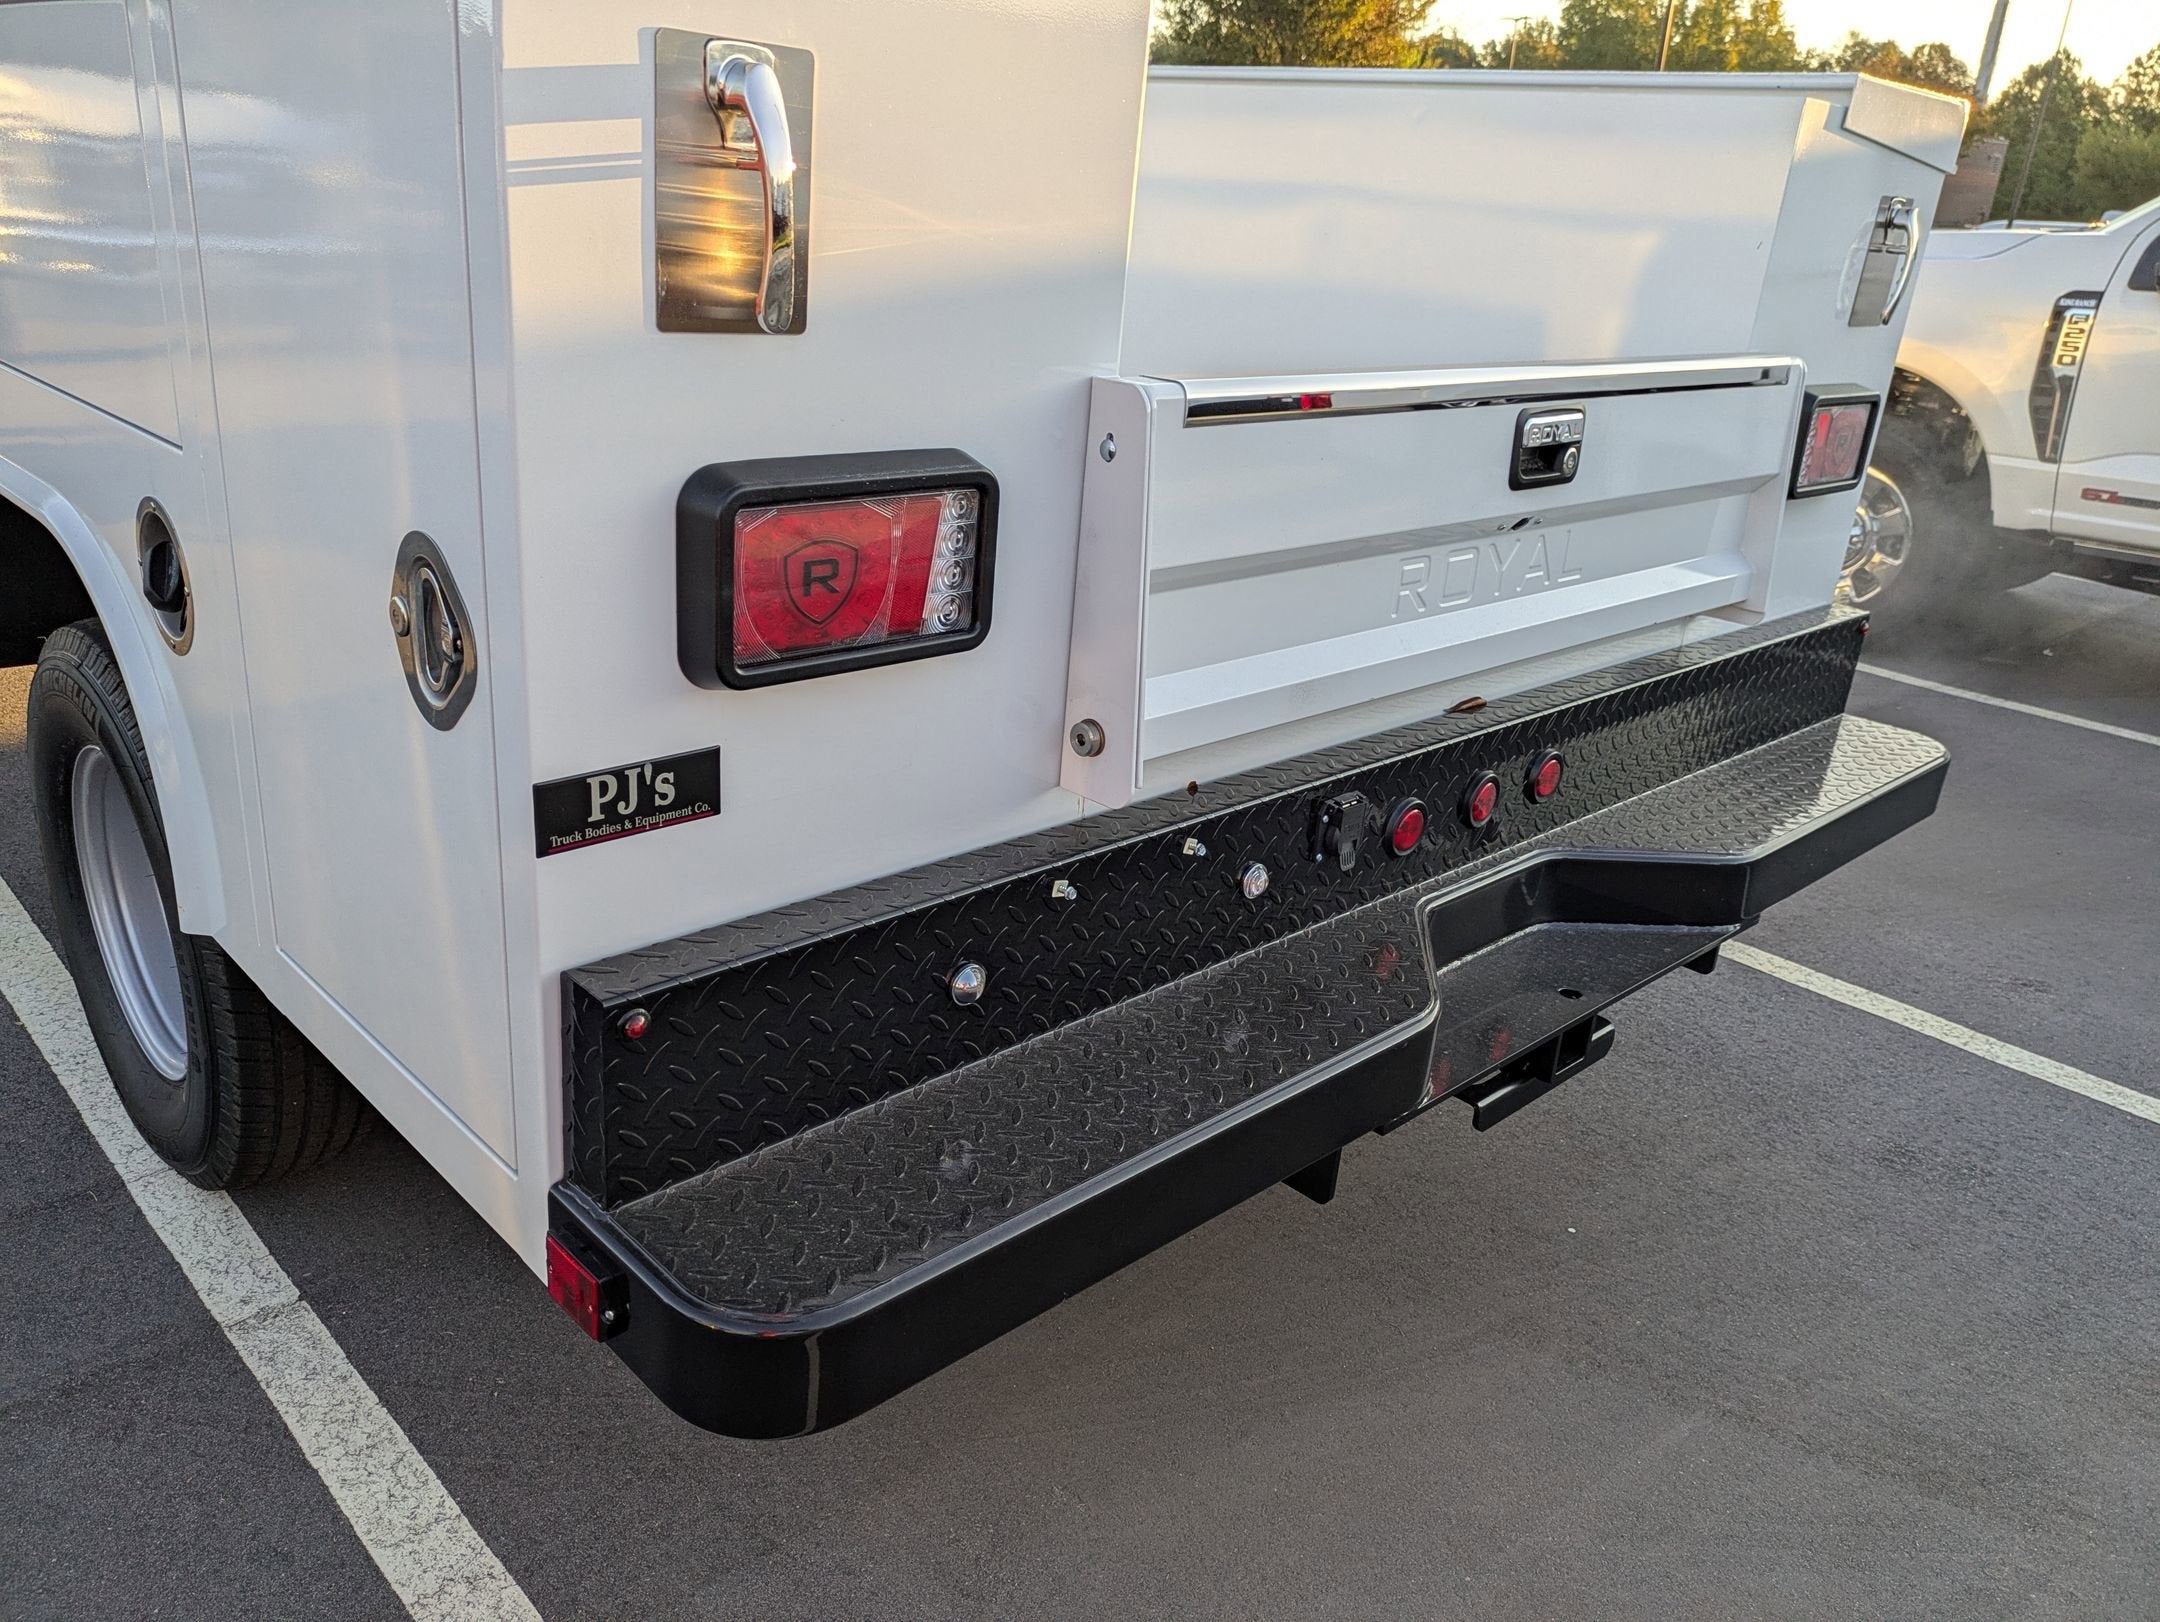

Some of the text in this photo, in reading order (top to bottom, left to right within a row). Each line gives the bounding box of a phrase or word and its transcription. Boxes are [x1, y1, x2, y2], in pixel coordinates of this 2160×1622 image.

[1529, 423, 1582, 444] ROYAL
[802, 558, 840, 597] R
[1391, 529, 1582, 618] ROYAL
[586, 762, 676, 823] PJ's
[550, 802, 711, 848] Truck Bodies & Equipment Co.
